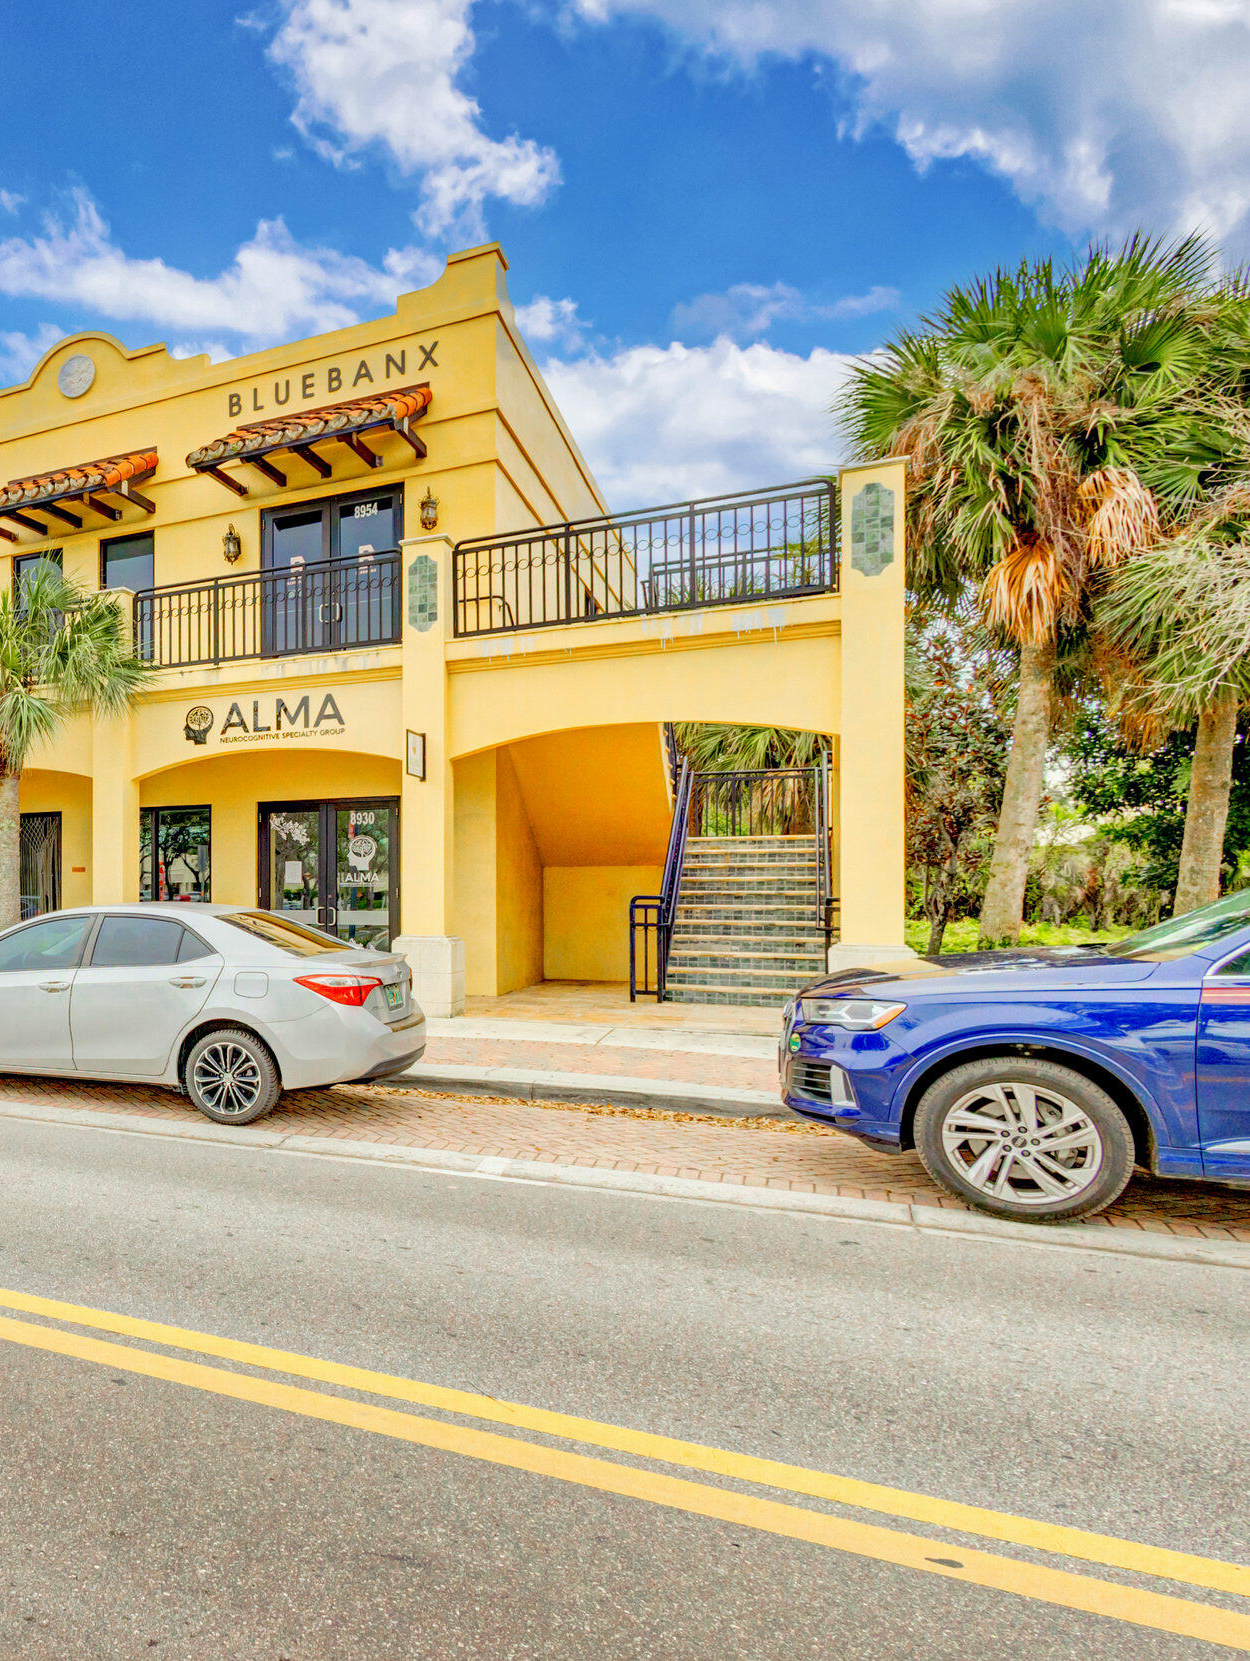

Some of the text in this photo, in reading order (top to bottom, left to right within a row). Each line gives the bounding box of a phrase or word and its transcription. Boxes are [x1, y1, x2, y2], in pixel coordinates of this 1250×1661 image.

[228, 340, 439, 418] BLUEBANX
[354, 502, 378, 519] 8954
[220, 693, 345, 735] ALMA
[220, 727, 345, 744] NEUROCOGNITIVE SPECIALTY GROUP
[350, 812, 375, 825] 8930
[345, 872, 379, 882] ALMA
